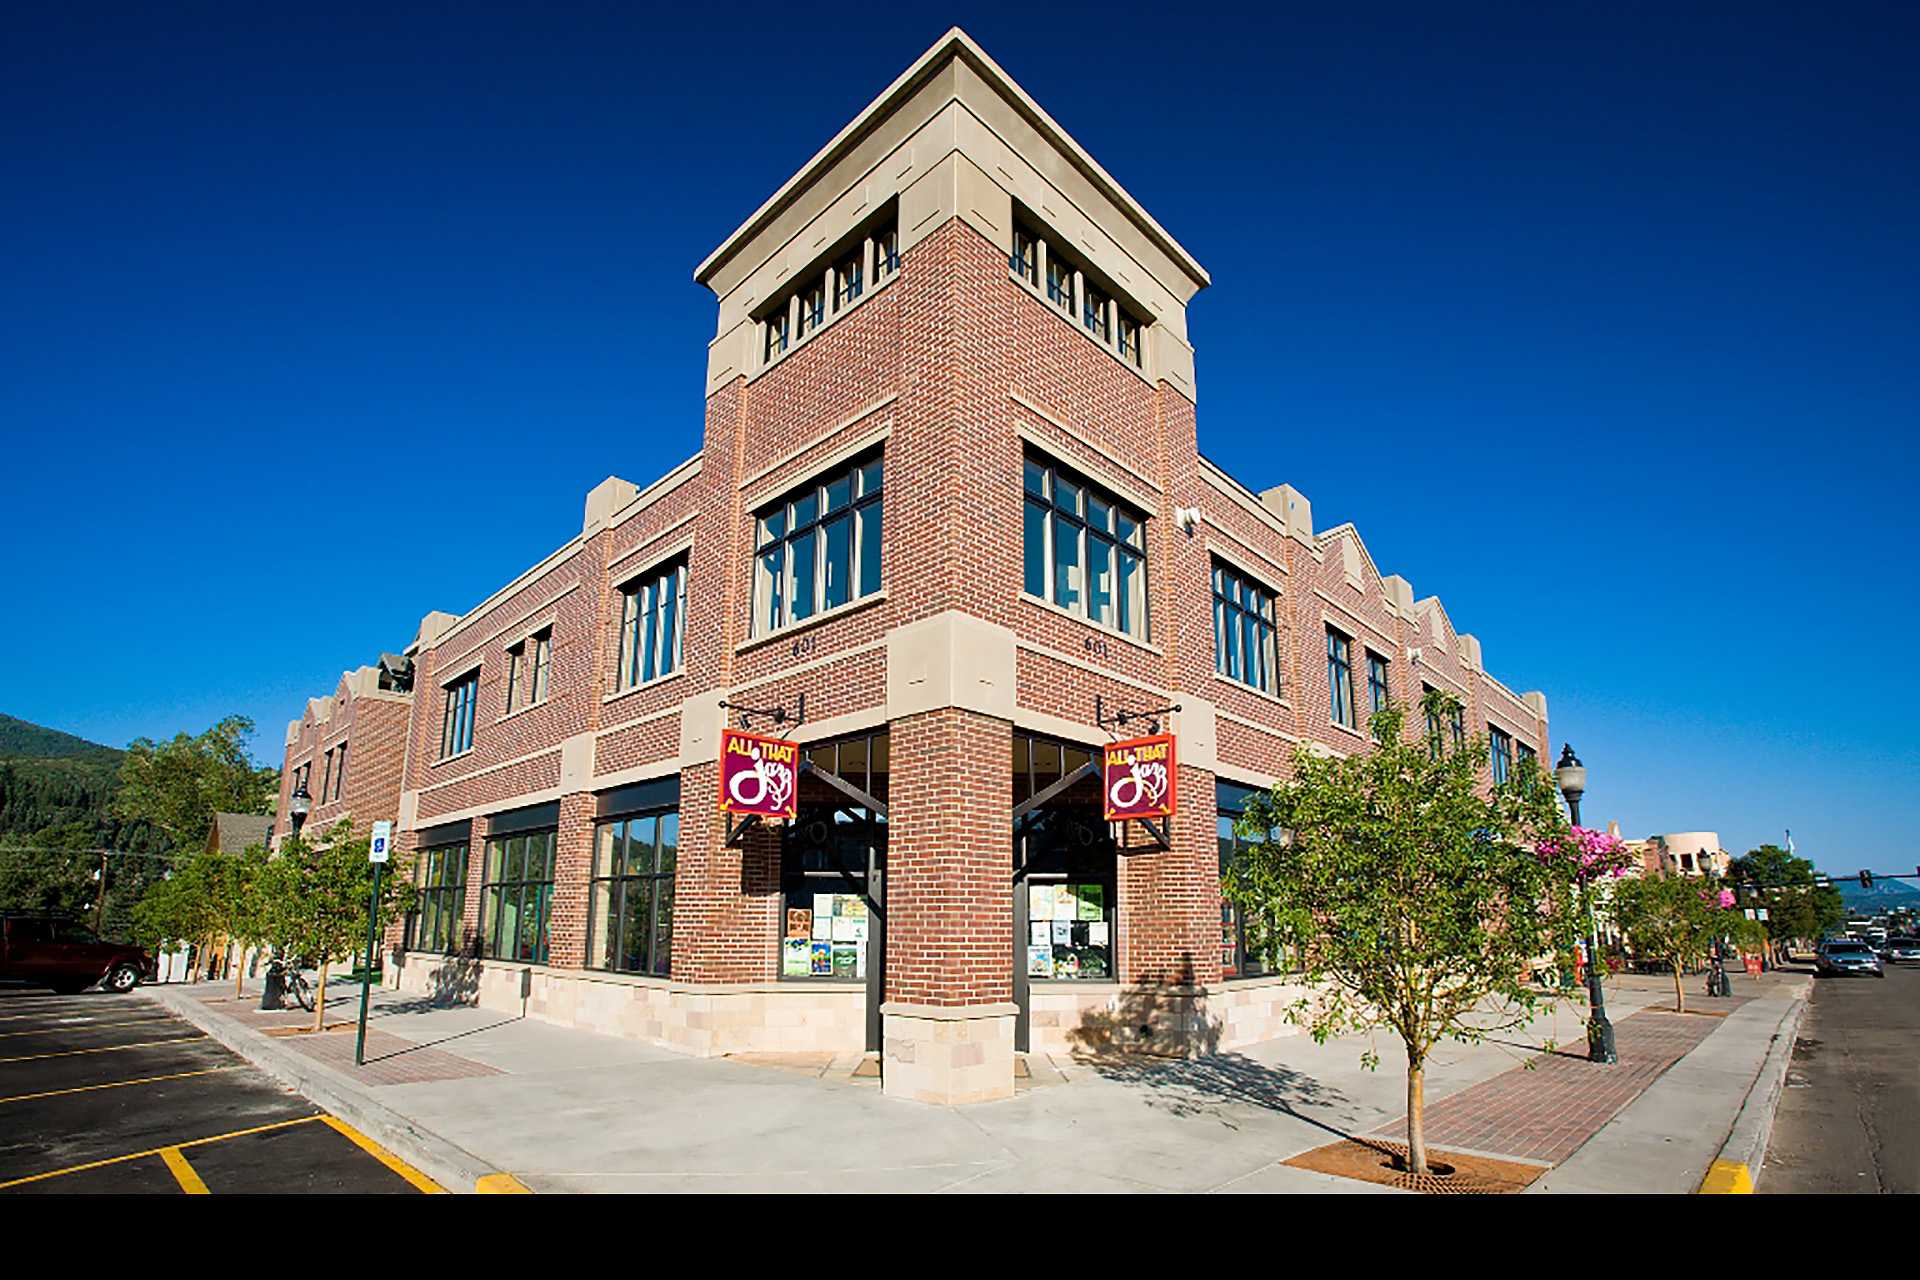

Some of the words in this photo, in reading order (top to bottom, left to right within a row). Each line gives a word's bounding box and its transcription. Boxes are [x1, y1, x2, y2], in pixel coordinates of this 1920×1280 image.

[727, 737, 753, 756] ALL
[759, 742, 795, 764] THAT
[1107, 750, 1129, 766] ALL
[1134, 744, 1168, 762] THAT
